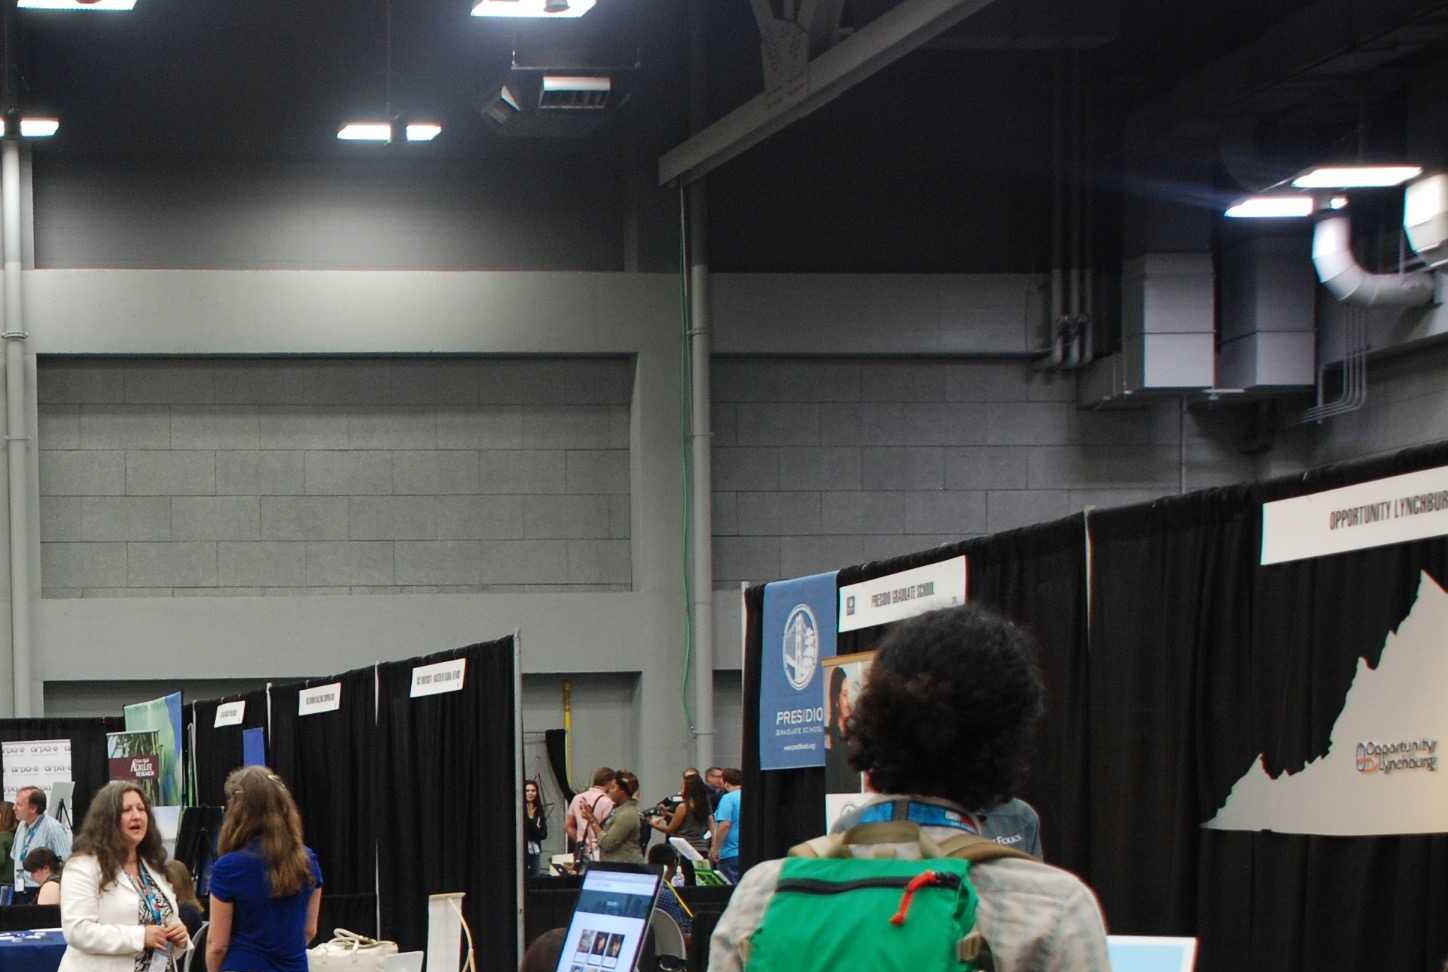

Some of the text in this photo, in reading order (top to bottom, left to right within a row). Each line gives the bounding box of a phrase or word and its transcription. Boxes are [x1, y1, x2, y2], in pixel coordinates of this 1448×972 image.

[1330, 501, 1391, 530] OPPORTUNITY
[775, 707, 824, 726] PRESIDIO
[1366, 741, 1437, 755] Opportunity
[1378, 755, 1437, 775] Lynchburg
